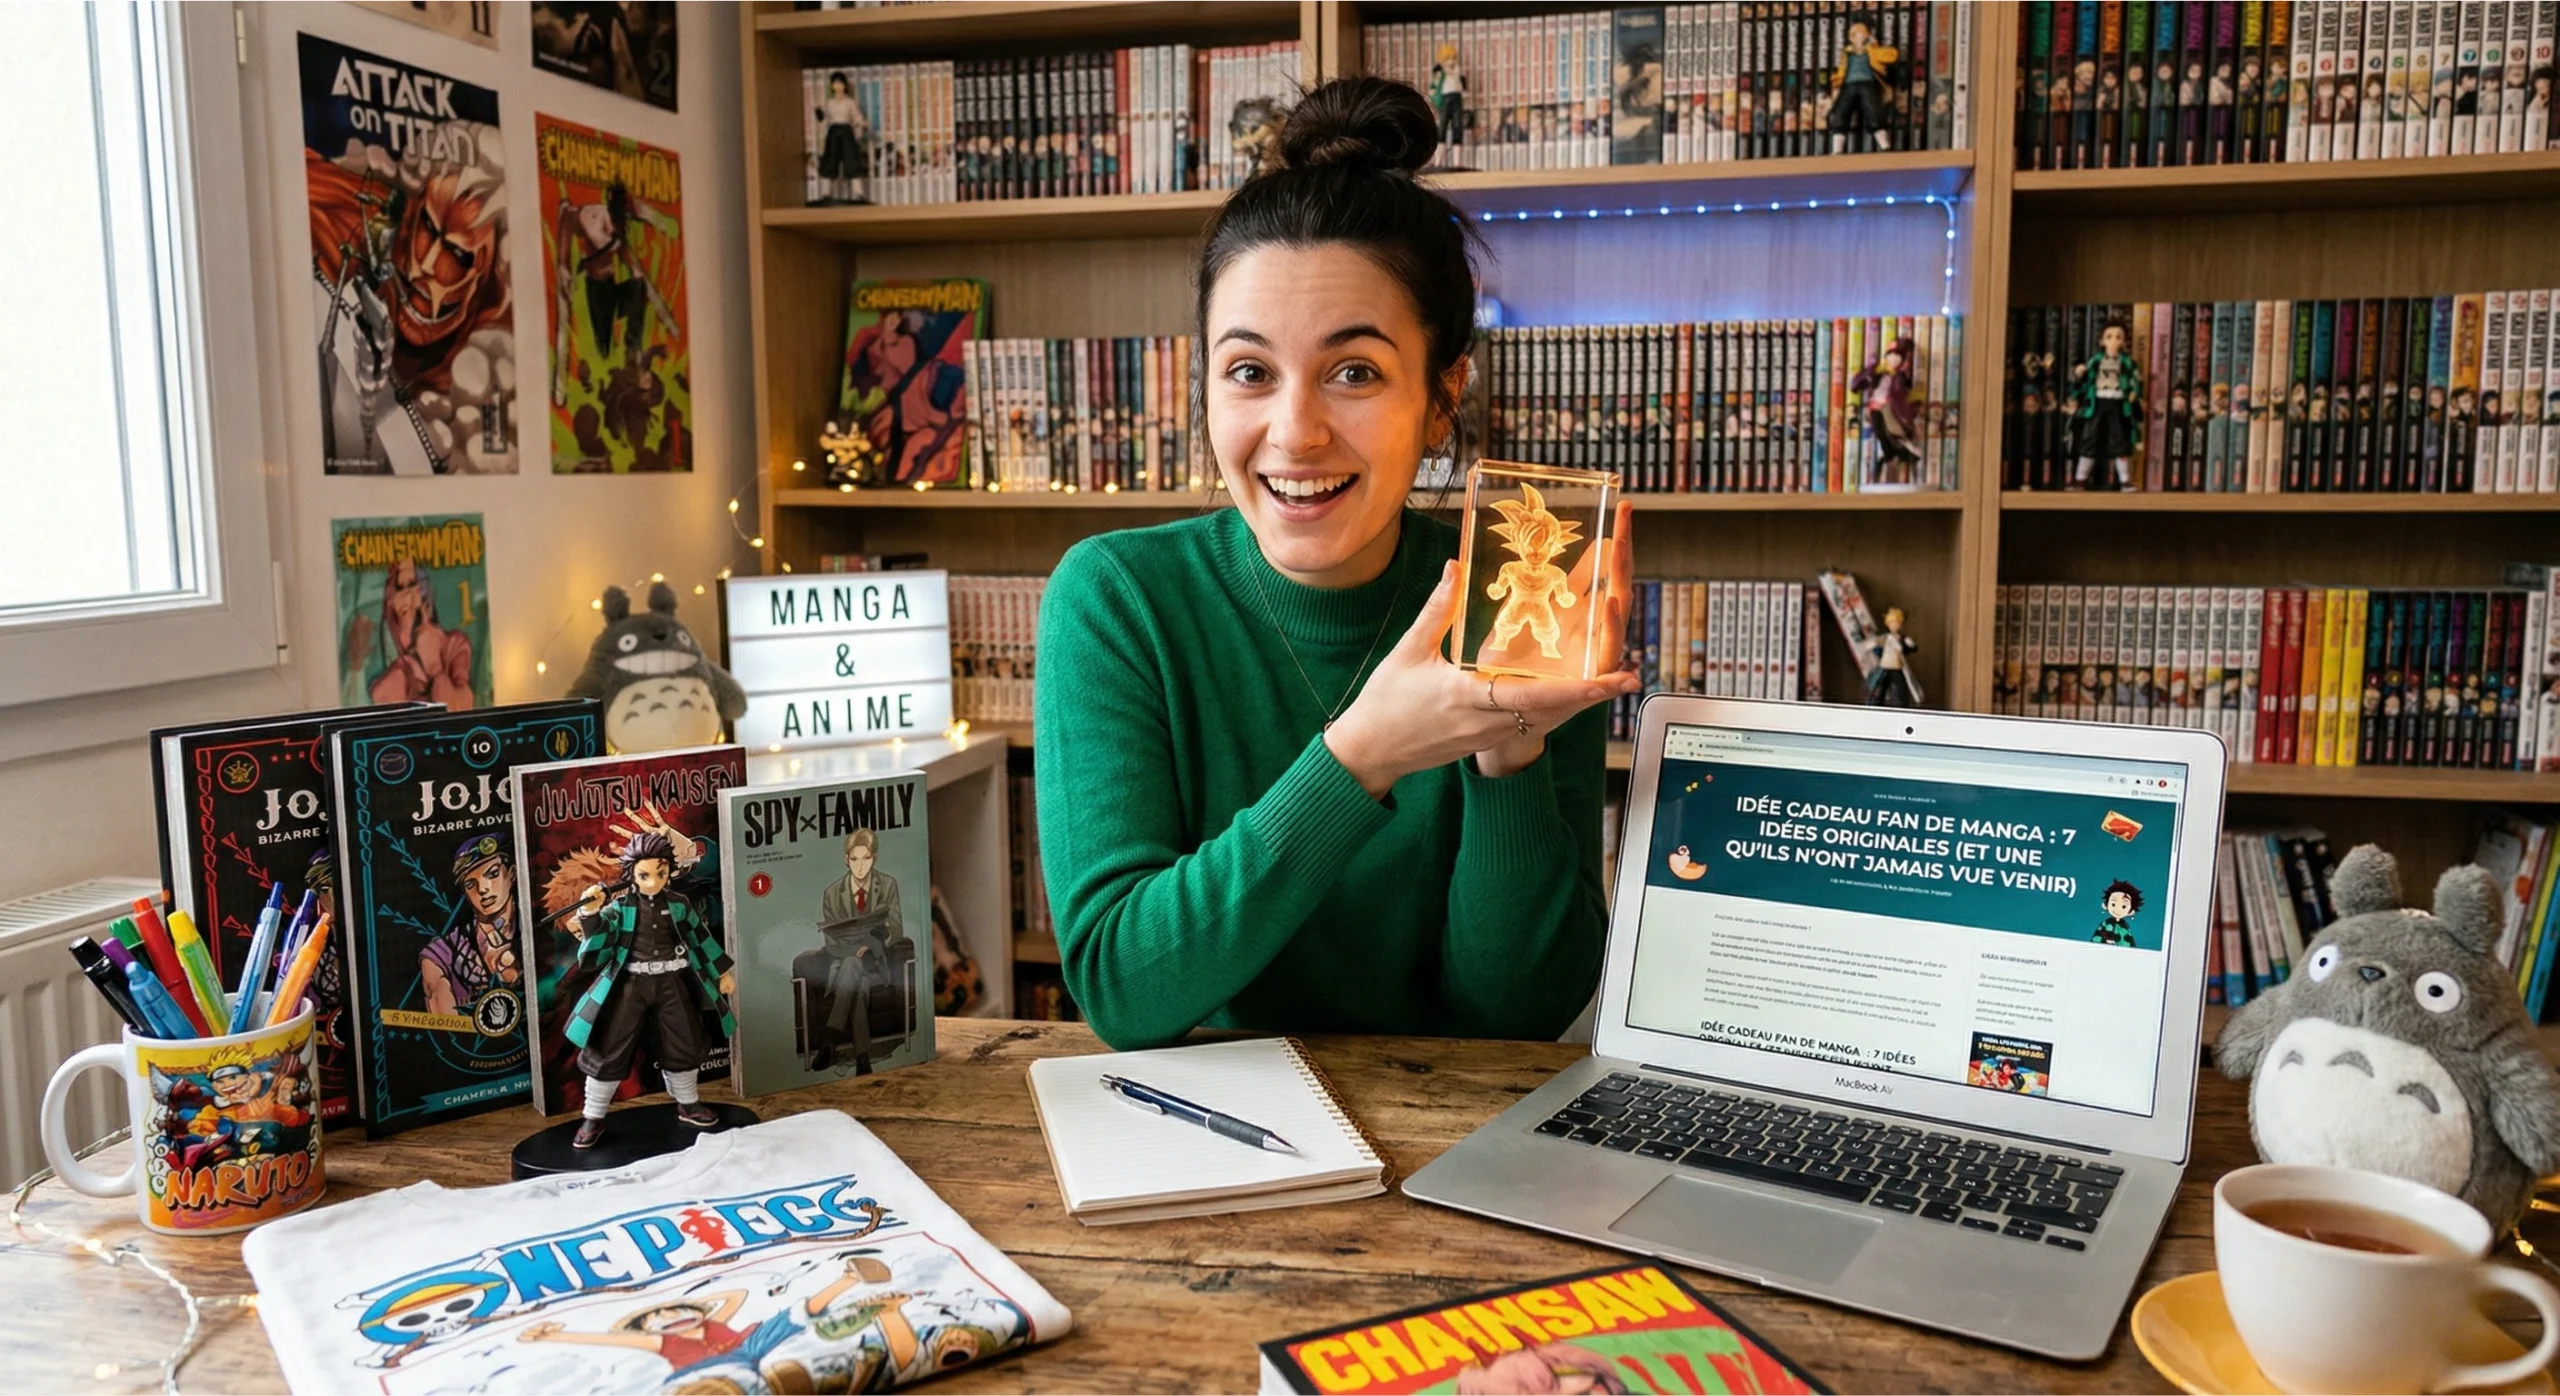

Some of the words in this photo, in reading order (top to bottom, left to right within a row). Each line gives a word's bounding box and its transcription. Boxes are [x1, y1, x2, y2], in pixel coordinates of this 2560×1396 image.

[330, 55, 458, 119] ATTACK
[458, 579, 480, 627] 1
[770, 583, 910, 626] MANGA
[835, 643, 855, 677] &
[782, 694, 915, 739] ANIME
[471, 741, 491, 755] 10
[535, 774, 642, 828] JUJUTSU
[649, 761, 739, 813] KAISEN
[258, 827, 321, 845] BIZARRE
[413, 819, 473, 837] BIZARRE
[1736, 795, 1782, 816] IDÉE
[1786, 802, 1871, 826] CADEAU
[1877, 811, 1920, 831] FAN
[1925, 815, 1955, 834] DE
[1960, 818, 2044, 844] MANGA
[2062, 829, 2077, 846] 7
[1759, 821, 1818, 842] IDÉES
[1822, 828, 1950, 857] ORIGINALES
[1955, 843, 1990, 862] (ET
[1995, 846, 2042, 867] UNE
[755, 878, 763, 891] 1
[1725, 839, 1790, 863] QU'ILS
[1795, 846, 1861, 870] N'ONT
[1863, 854, 1944, 880] JAMAIS
[1949, 865, 1995, 886] VUE
[2000, 870, 2077, 898] VENIR)
[1727, 1025, 1773, 1042] CADEAU
[1799, 1037, 1816, 1048] DE
[1818, 1040, 1860, 1056] MANGA
[1873, 1049, 1880, 1059] 7
[1834, 1076, 1878, 1093] MacBook
[165, 1150, 310, 1208] NARUTO
[358, 1231, 633, 1345] ONE
[620, 1180, 897, 1275] PIECE
[1299, 1266, 1697, 1394] CHAINSAW
